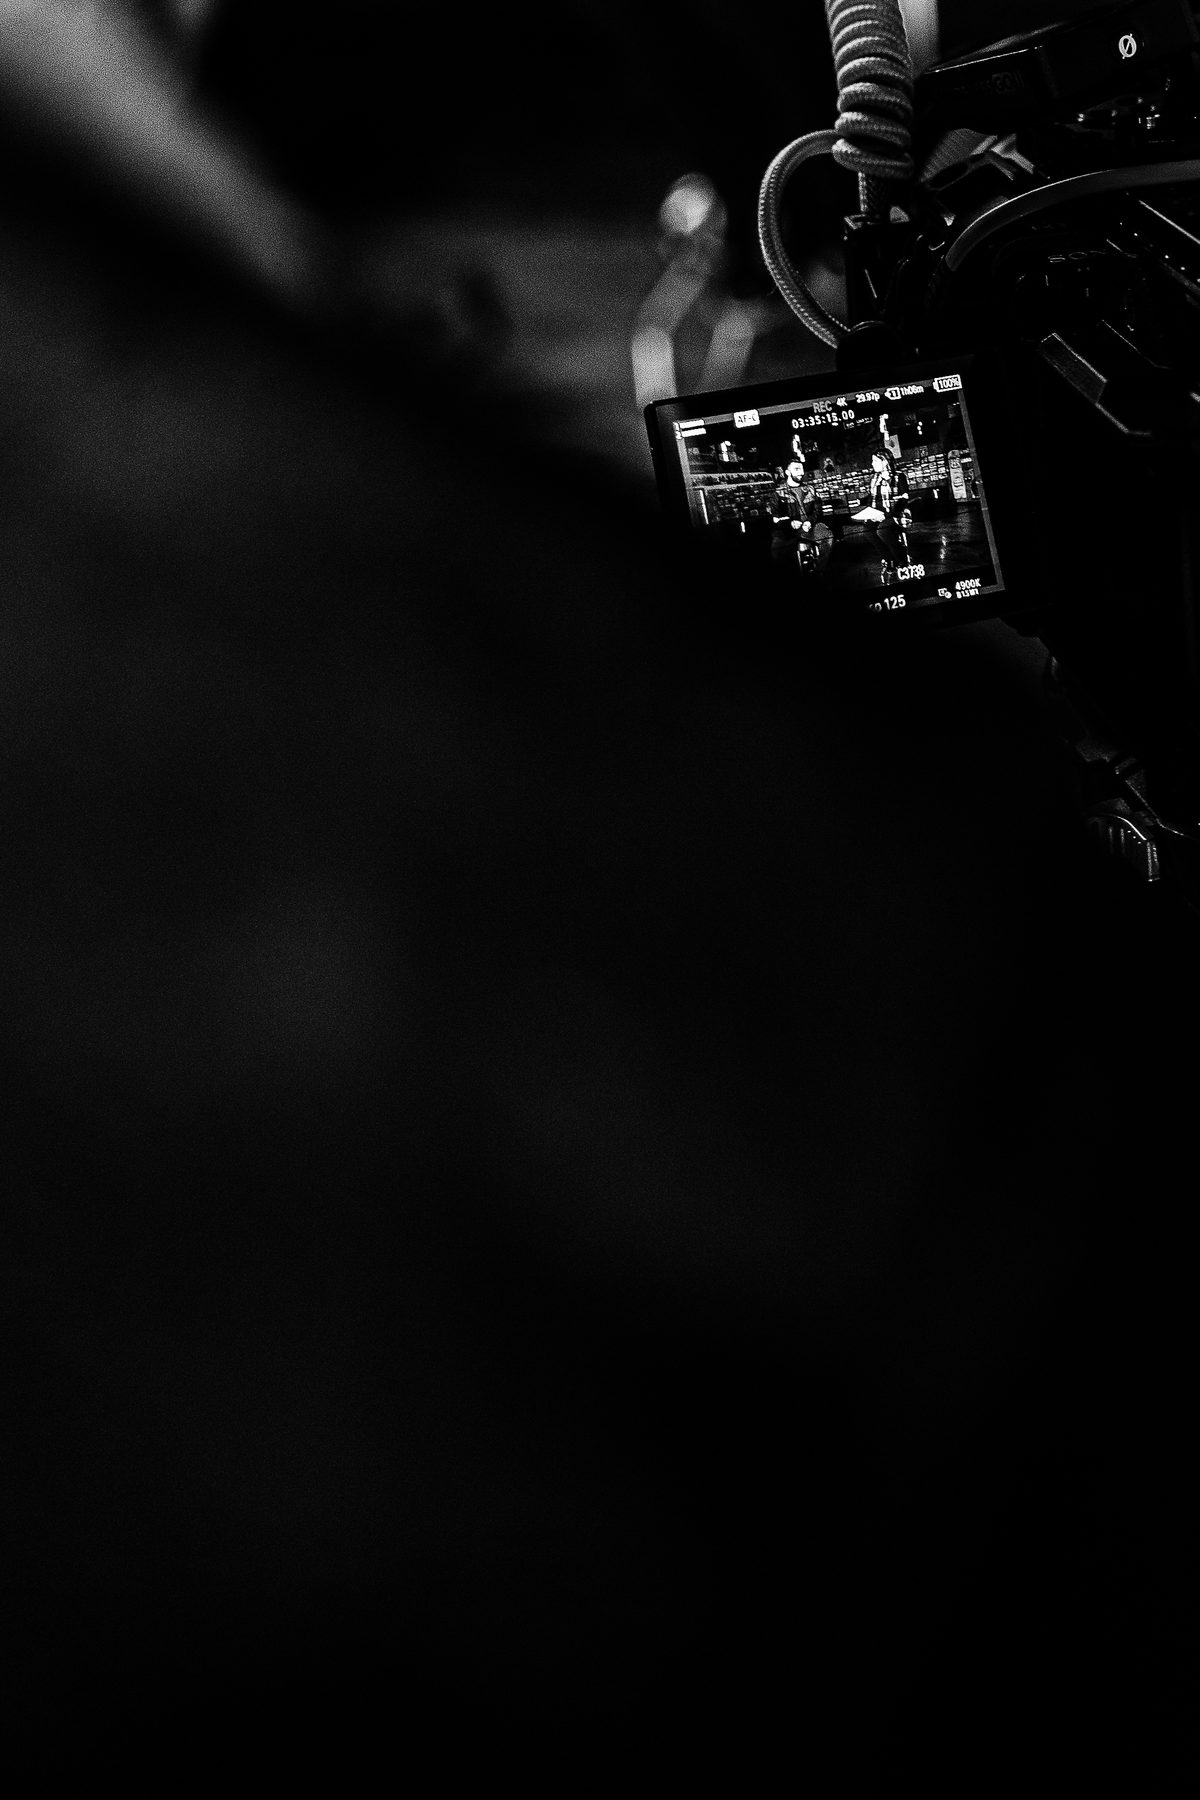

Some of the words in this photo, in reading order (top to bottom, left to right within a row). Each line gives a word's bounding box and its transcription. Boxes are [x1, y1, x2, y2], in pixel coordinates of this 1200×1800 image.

[836, 396, 848, 407] 4K
[938, 377, 960, 389] 100%
[812, 399, 833, 414] REC
[735, 411, 757, 424] AF-C
[791, 409, 855, 429] 03:35:15.00
[955, 577, 982, 591] 4900K
[882, 594, 907, 611] 125
